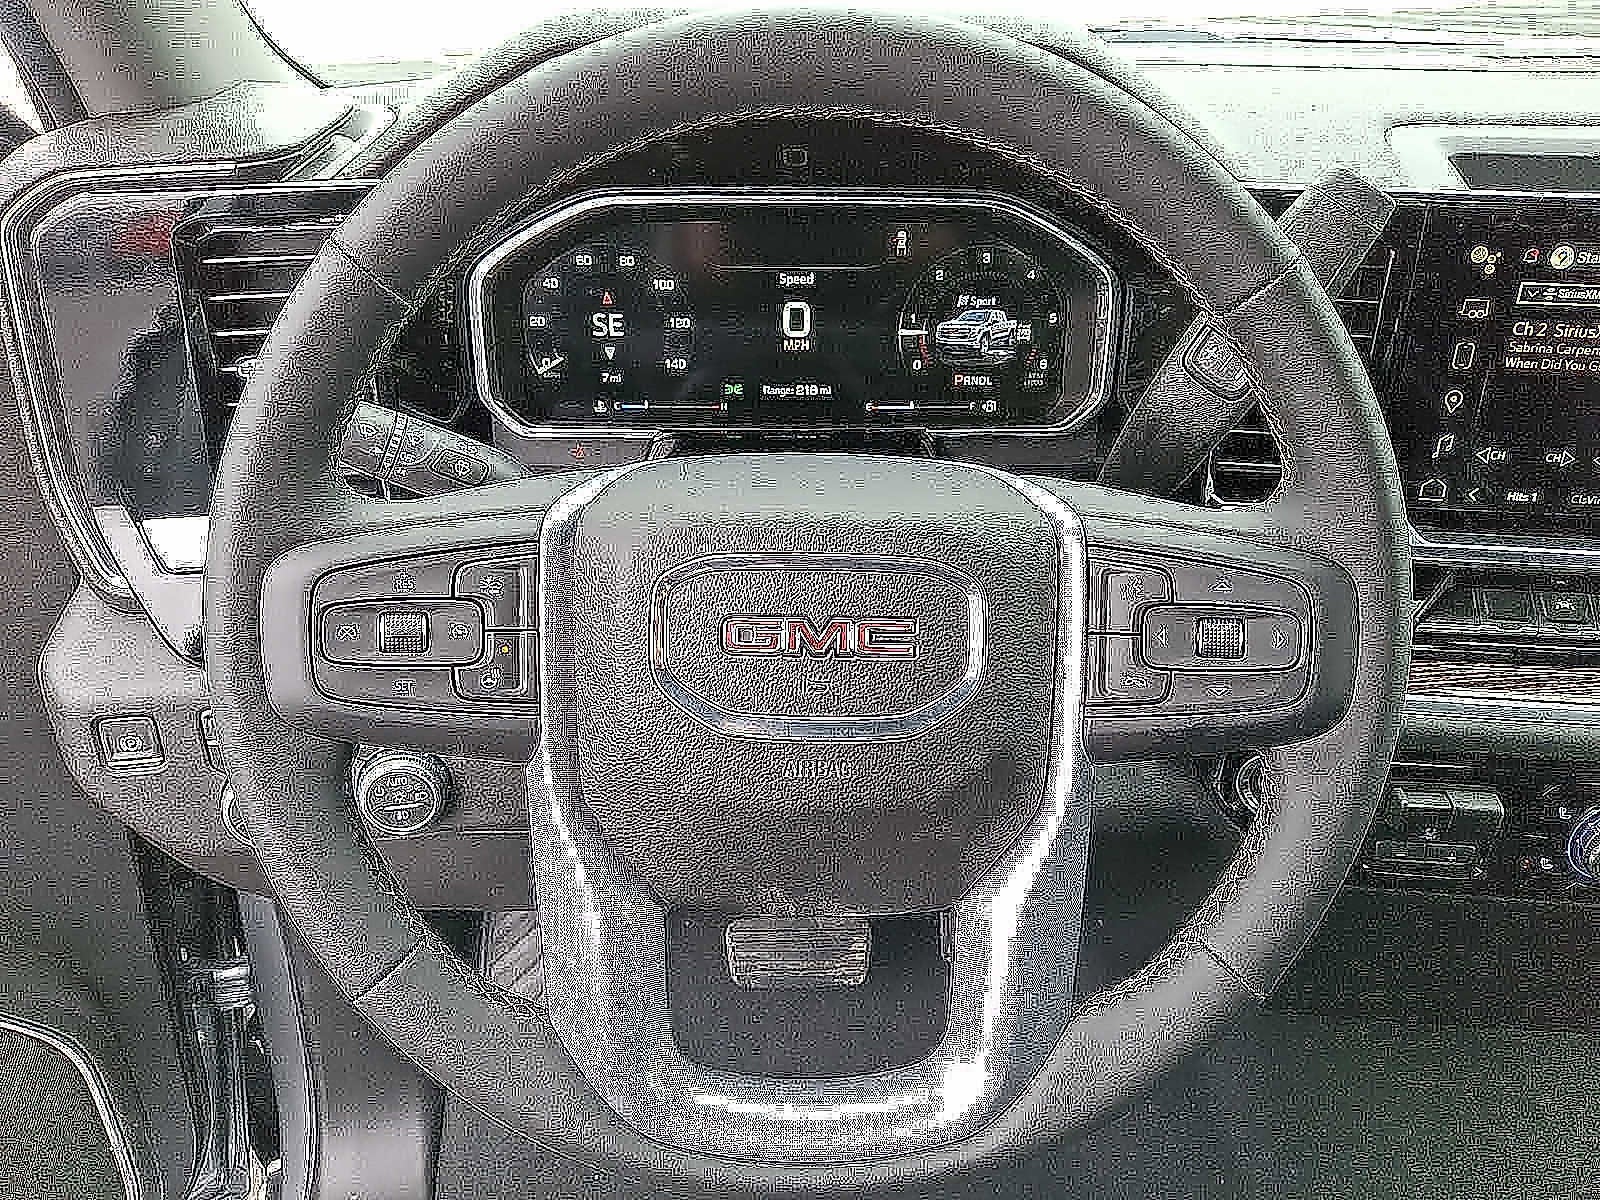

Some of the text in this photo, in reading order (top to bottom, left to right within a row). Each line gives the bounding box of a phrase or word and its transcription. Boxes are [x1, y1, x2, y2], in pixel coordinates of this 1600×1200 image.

[982, 253, 990, 263] 3
[779, 273, 814, 286] Speed
[936, 270, 944, 280] 2
[1026, 269, 1036, 280] 4
[543, 278, 559, 288] 40
[653, 280, 675, 290] 100
[970, 296, 997, 308] Sport
[529, 316, 545, 327] 20
[782, 301, 811, 338] 0
[910, 314, 917, 323] 1
[1049, 313, 1058, 324] 5
[592, 313, 624, 336] SE
[1512, 321, 1534, 336] Ch
[1536, 323, 1548, 337] 2
[783, 340, 810, 350] MPH
[1508, 341, 1553, 354] Sabrina
[665, 359, 687, 369] 140
[913, 360, 921, 370] 0
[1505, 356, 1538, 369] When
[1541, 358, 1563, 370] Did
[1565, 360, 1586, 371] You
[601, 373, 621, 383] 7 mi
[762, 385, 795, 397] Range:
[820, 385, 832, 395] mi
[1490, 451, 1506, 460] CH
[1545, 454, 1561, 462] CH
[721, 615, 919, 659] GMC
[395, 680, 415, 691] SET
[783, 760, 852, 778] AIRBAG
